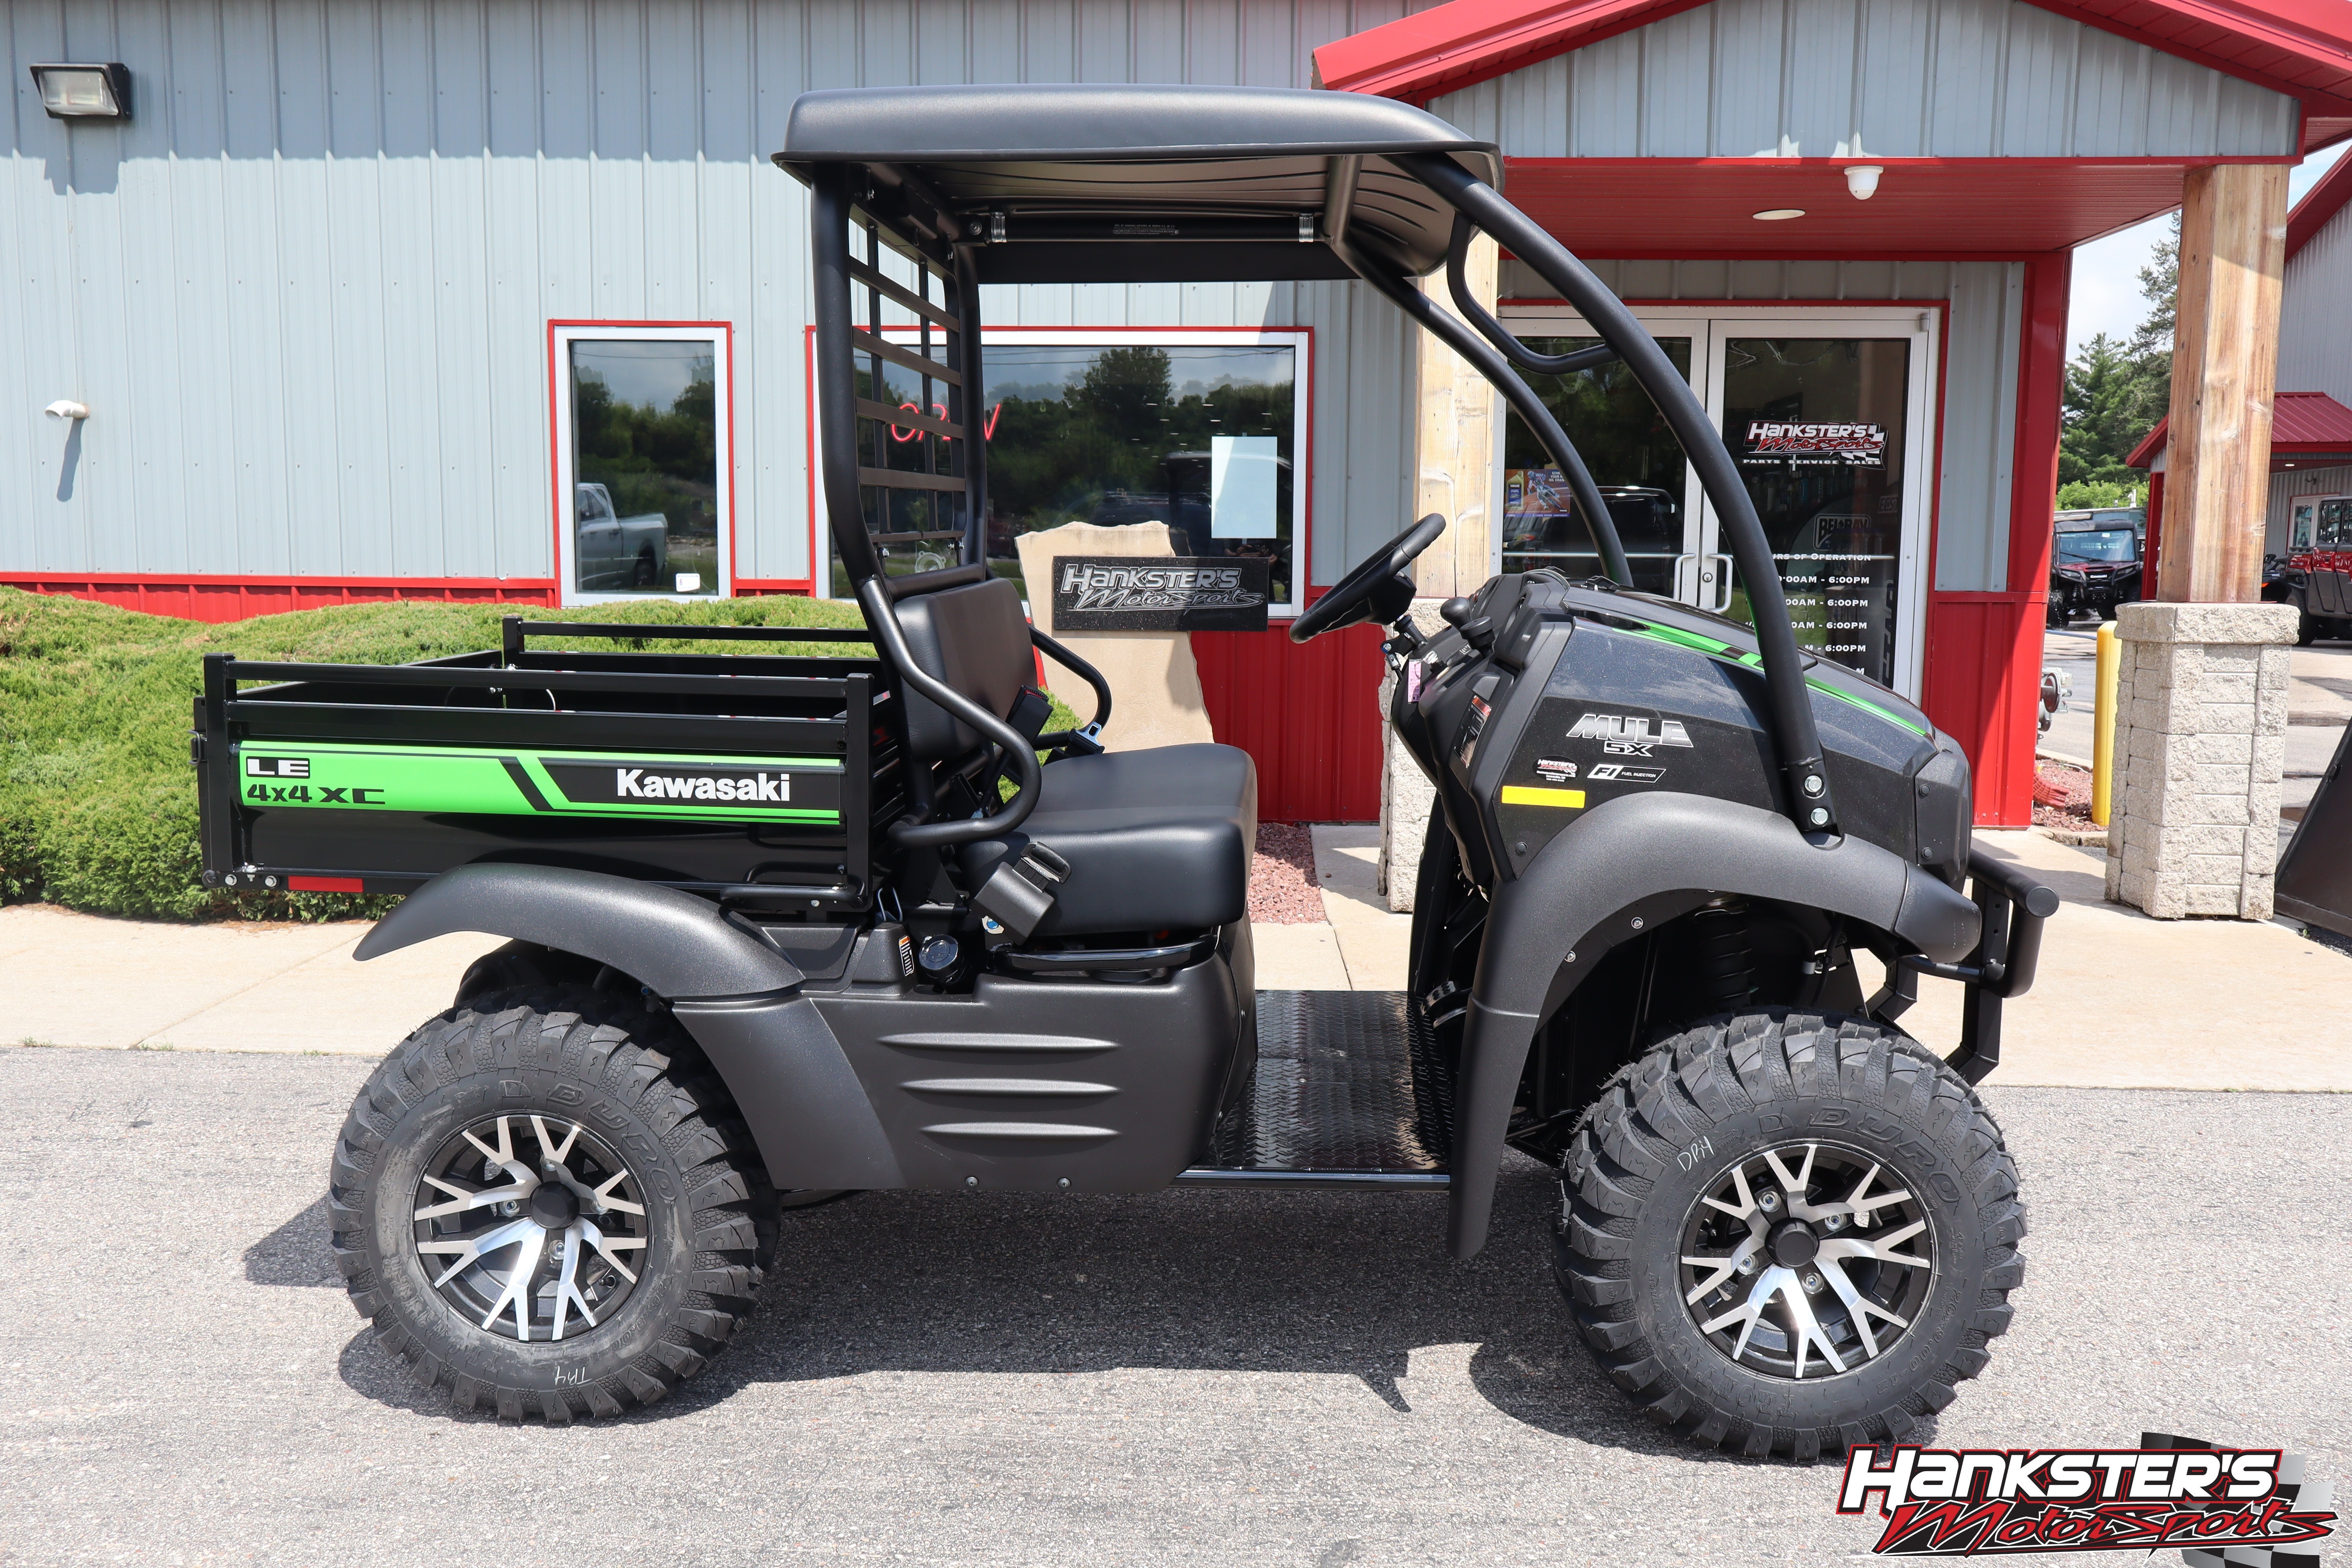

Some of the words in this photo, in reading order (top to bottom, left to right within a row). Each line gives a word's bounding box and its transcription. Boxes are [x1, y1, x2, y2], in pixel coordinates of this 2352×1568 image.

[1811, 553, 1871, 561] OPERATION
[1566, 713, 1694, 748] MULE
[1604, 741, 1655, 757] SX
[247, 758, 309, 776] LE
[247, 784, 312, 803] 4x4
[317, 787, 386, 805] XC
[617, 768, 790, 801] Kawasaki
[546, 1083, 679, 1201] DURO
[1809, 1106, 1960, 1203] DURO
